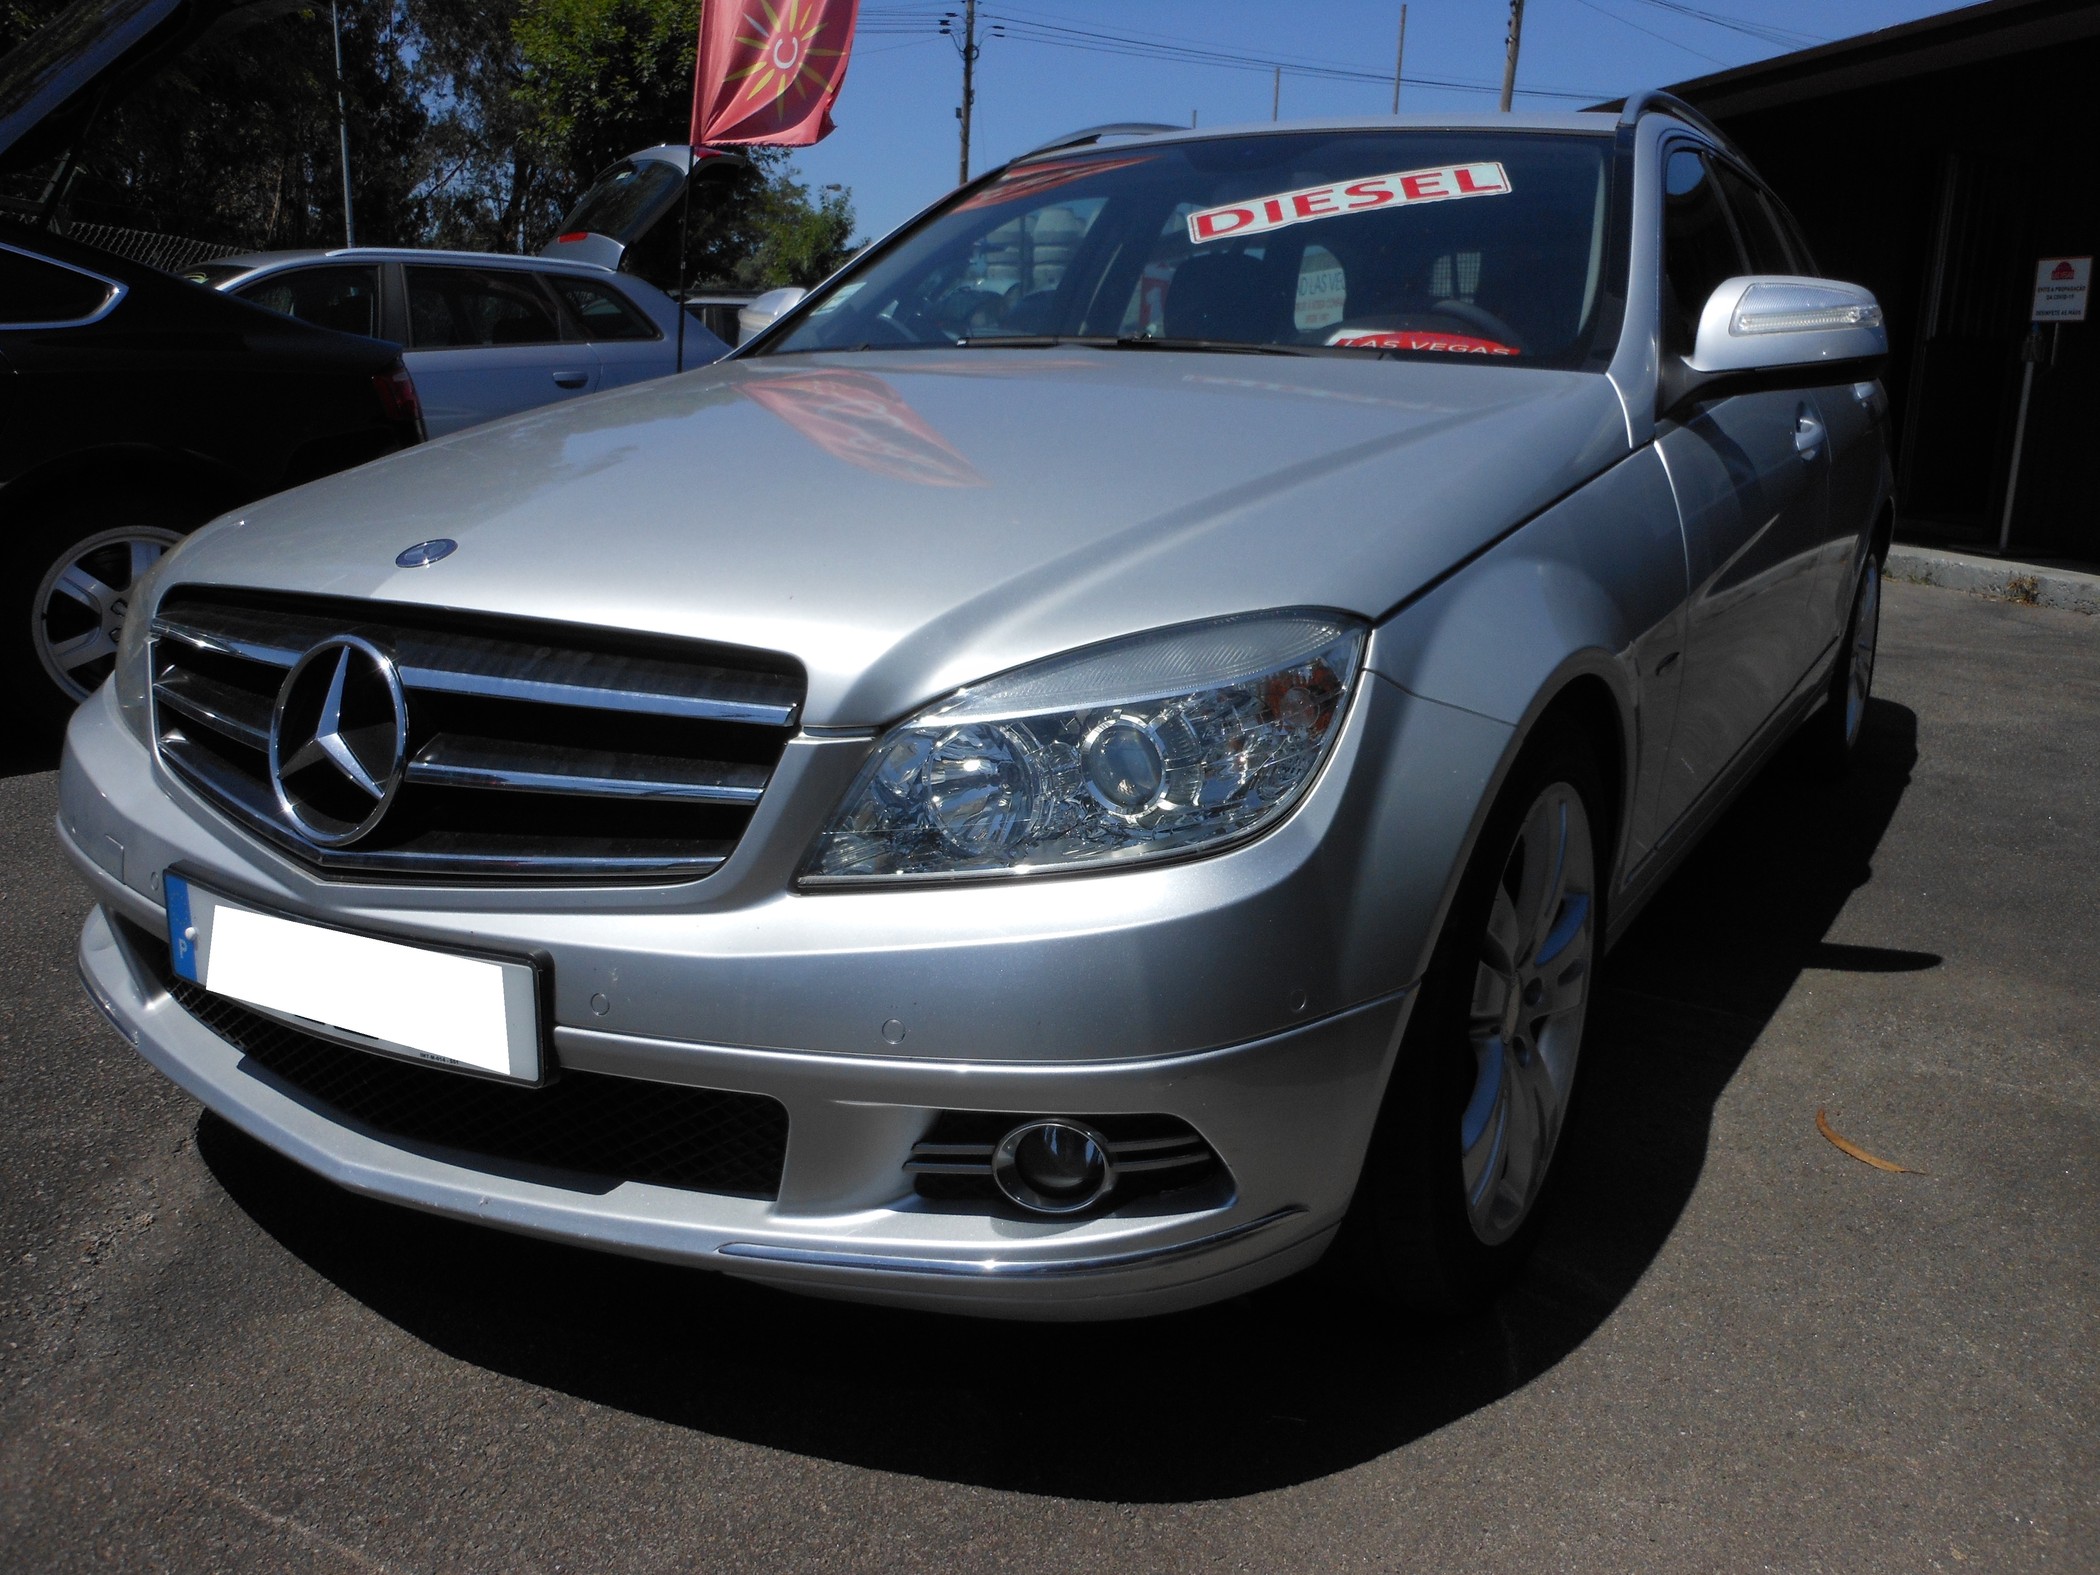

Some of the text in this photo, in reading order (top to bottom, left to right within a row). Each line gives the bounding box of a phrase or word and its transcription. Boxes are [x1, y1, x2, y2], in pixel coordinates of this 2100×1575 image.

[1196, 169, 1502, 238] DIESEL
[1344, 340, 1511, 355] LAS VEGAS
[178, 938, 188, 959] P
